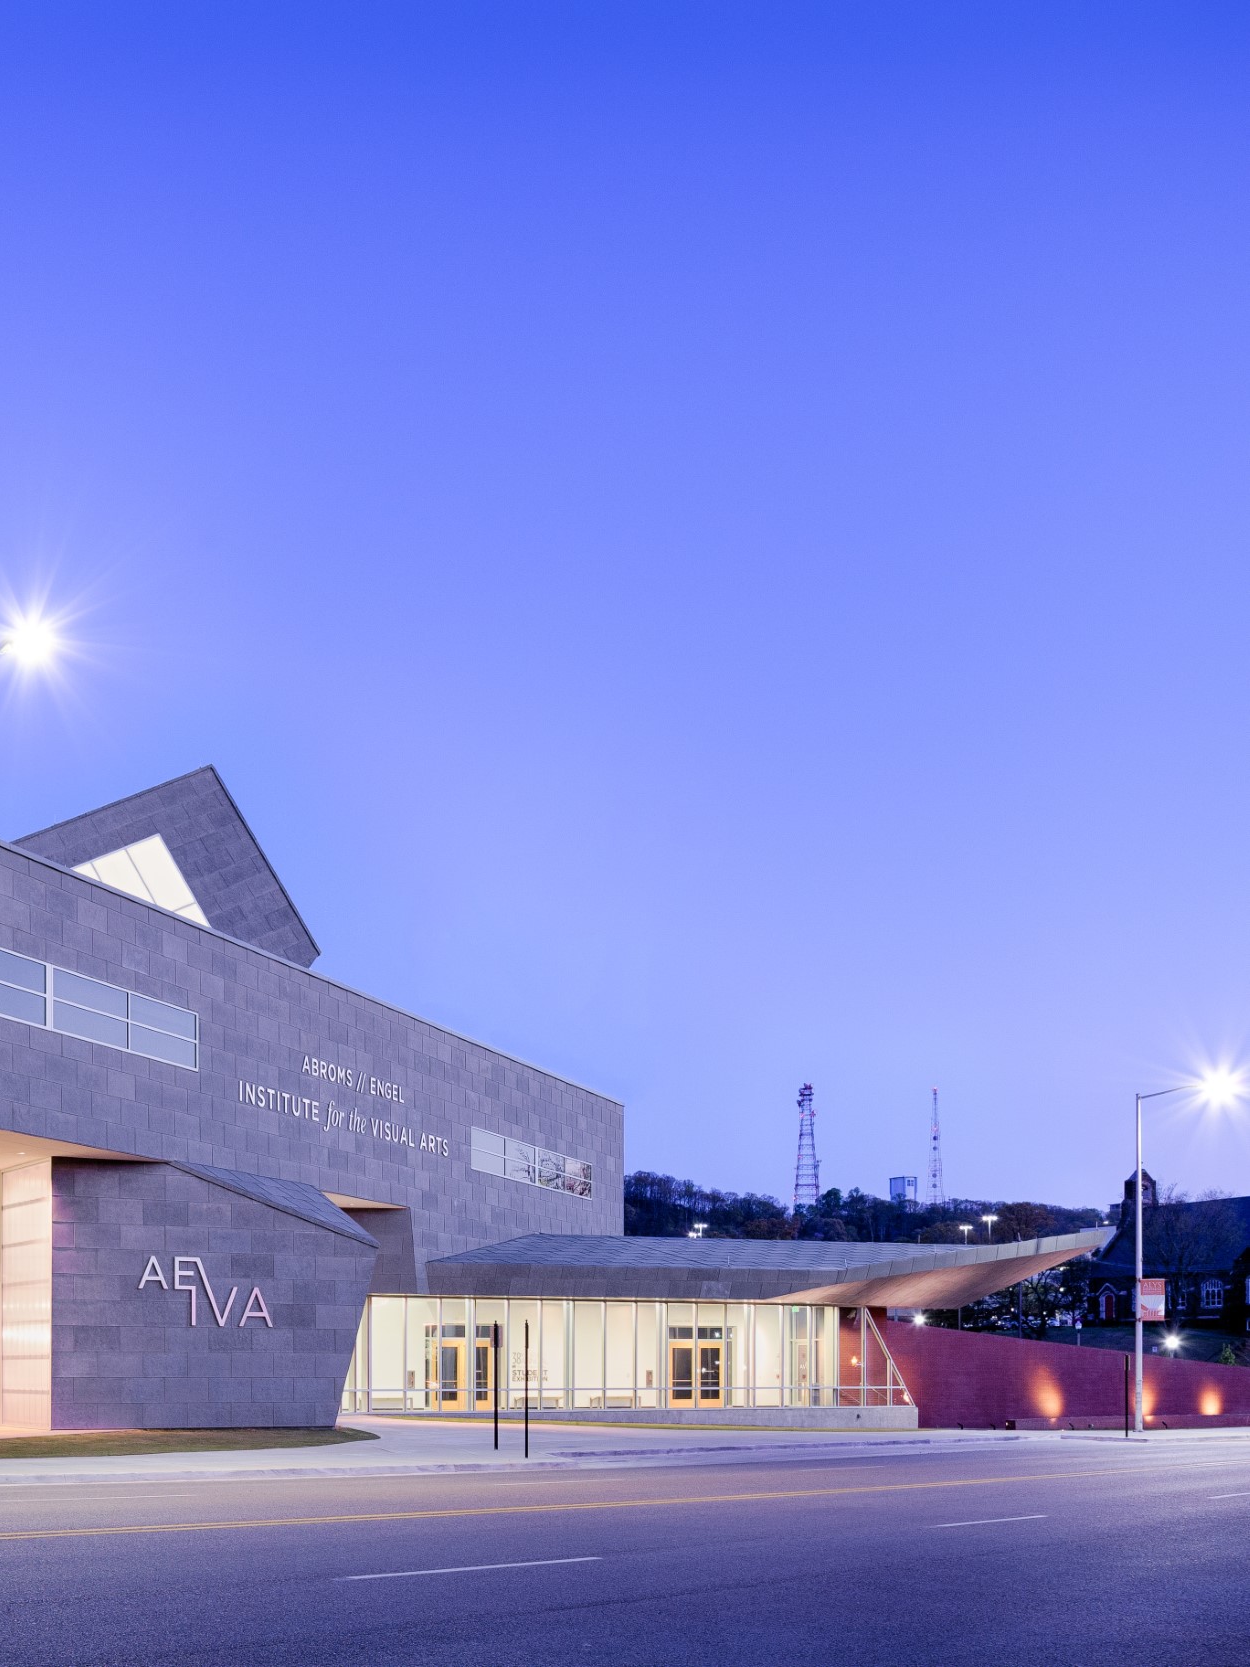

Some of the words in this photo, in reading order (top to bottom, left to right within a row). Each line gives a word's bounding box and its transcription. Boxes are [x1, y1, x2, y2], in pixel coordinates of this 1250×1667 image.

[302, 1055, 353, 1087] ABROMS
[370, 1077, 405, 1103] ENGEL
[238, 1080, 320, 1122] INSTITUTE
[323, 1100, 345, 1132] for
[348, 1107, 367, 1134] the
[370, 1117, 415, 1148] VISUAL
[419, 1132, 449, 1157] ARTS
